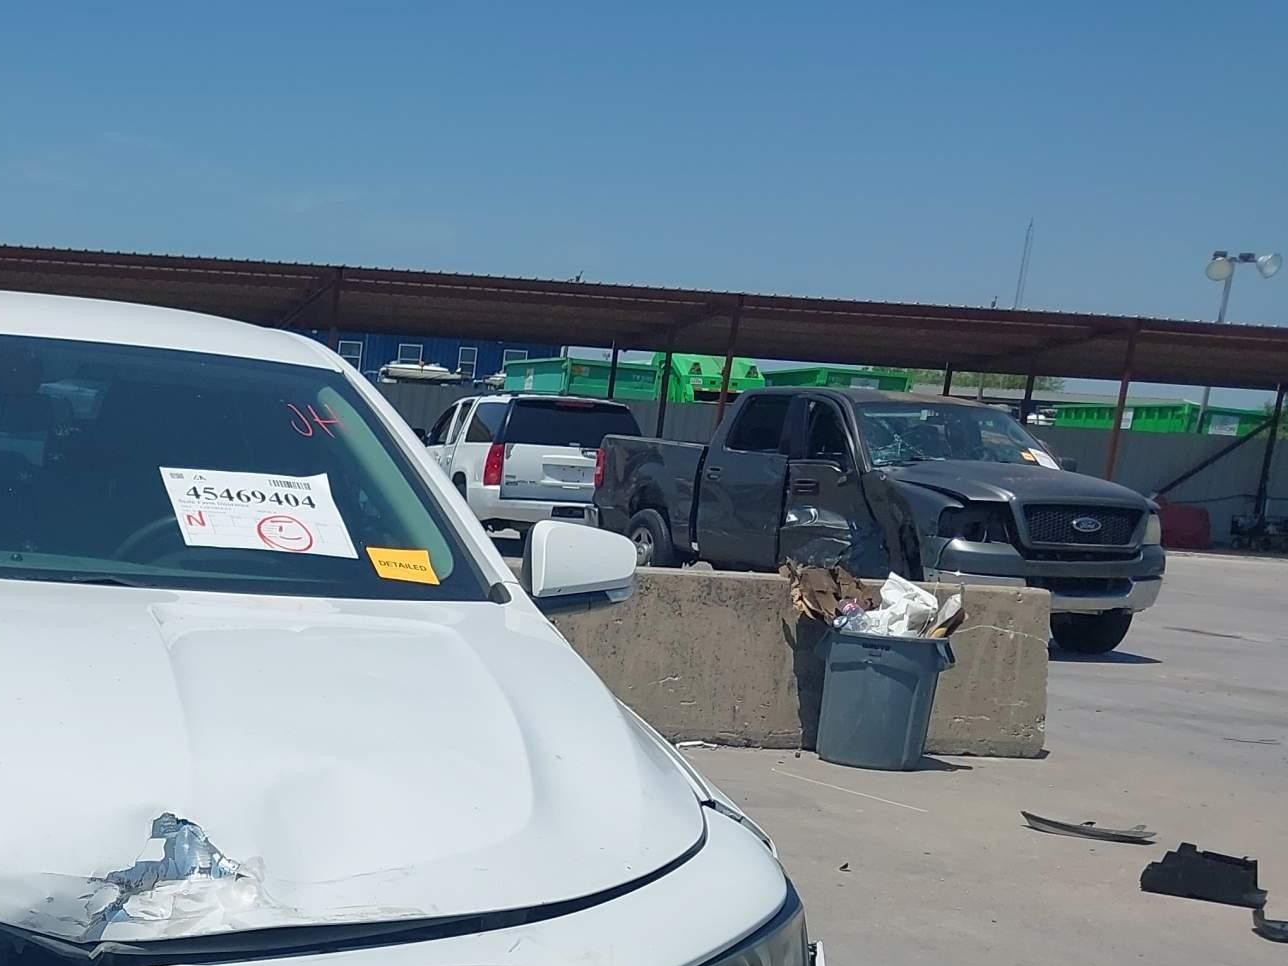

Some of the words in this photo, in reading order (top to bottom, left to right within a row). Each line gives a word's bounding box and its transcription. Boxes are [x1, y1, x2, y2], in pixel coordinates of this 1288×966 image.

[185, 485, 317, 510] 45469404
[185, 510, 207, 528] N
[378, 560, 427, 572] DETAILED
